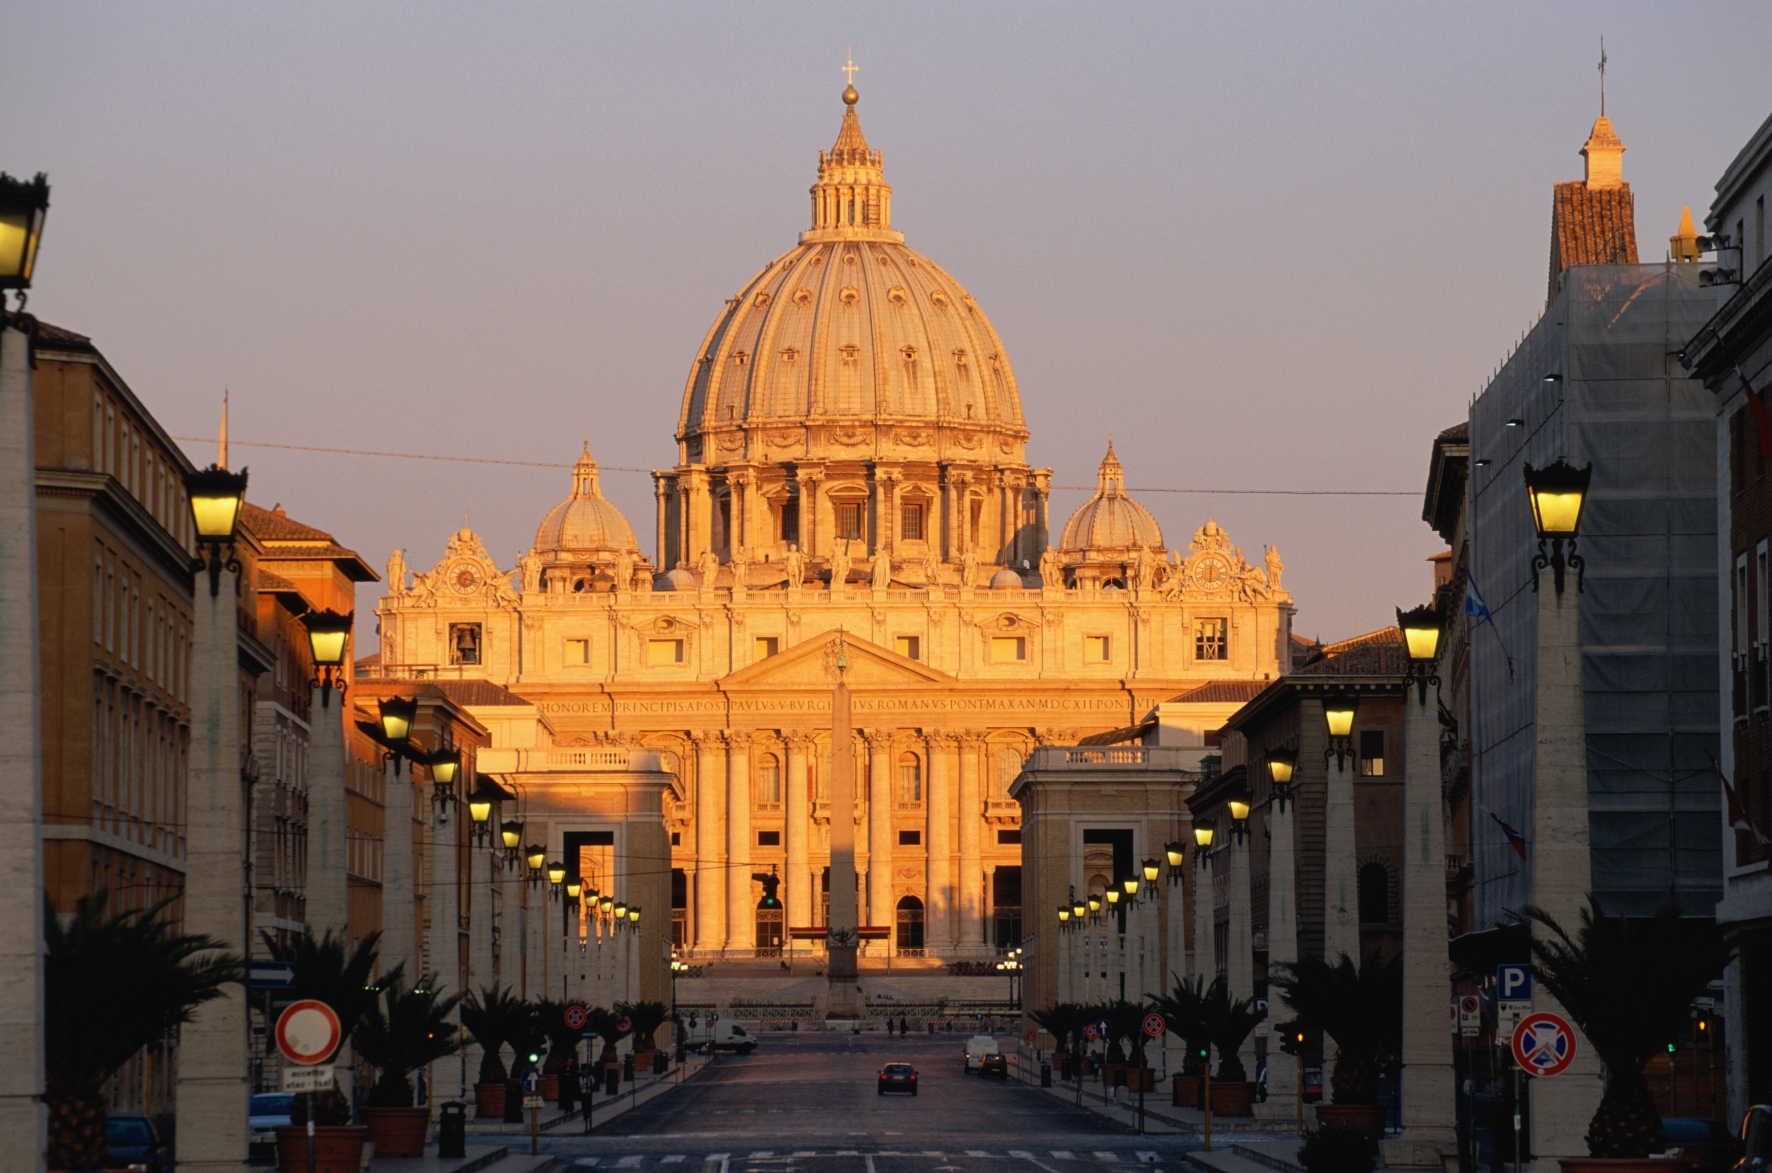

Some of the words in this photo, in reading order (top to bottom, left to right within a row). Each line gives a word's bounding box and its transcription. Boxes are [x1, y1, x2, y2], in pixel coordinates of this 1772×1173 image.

[541, 702, 612, 713] HONOREM
[615, 702, 685, 712] PRINCIPIS
[731, 700, 776, 711] PAVLVS
[877, 699, 947, 710] ROMANVS
[1504, 968, 1525, 997] P
